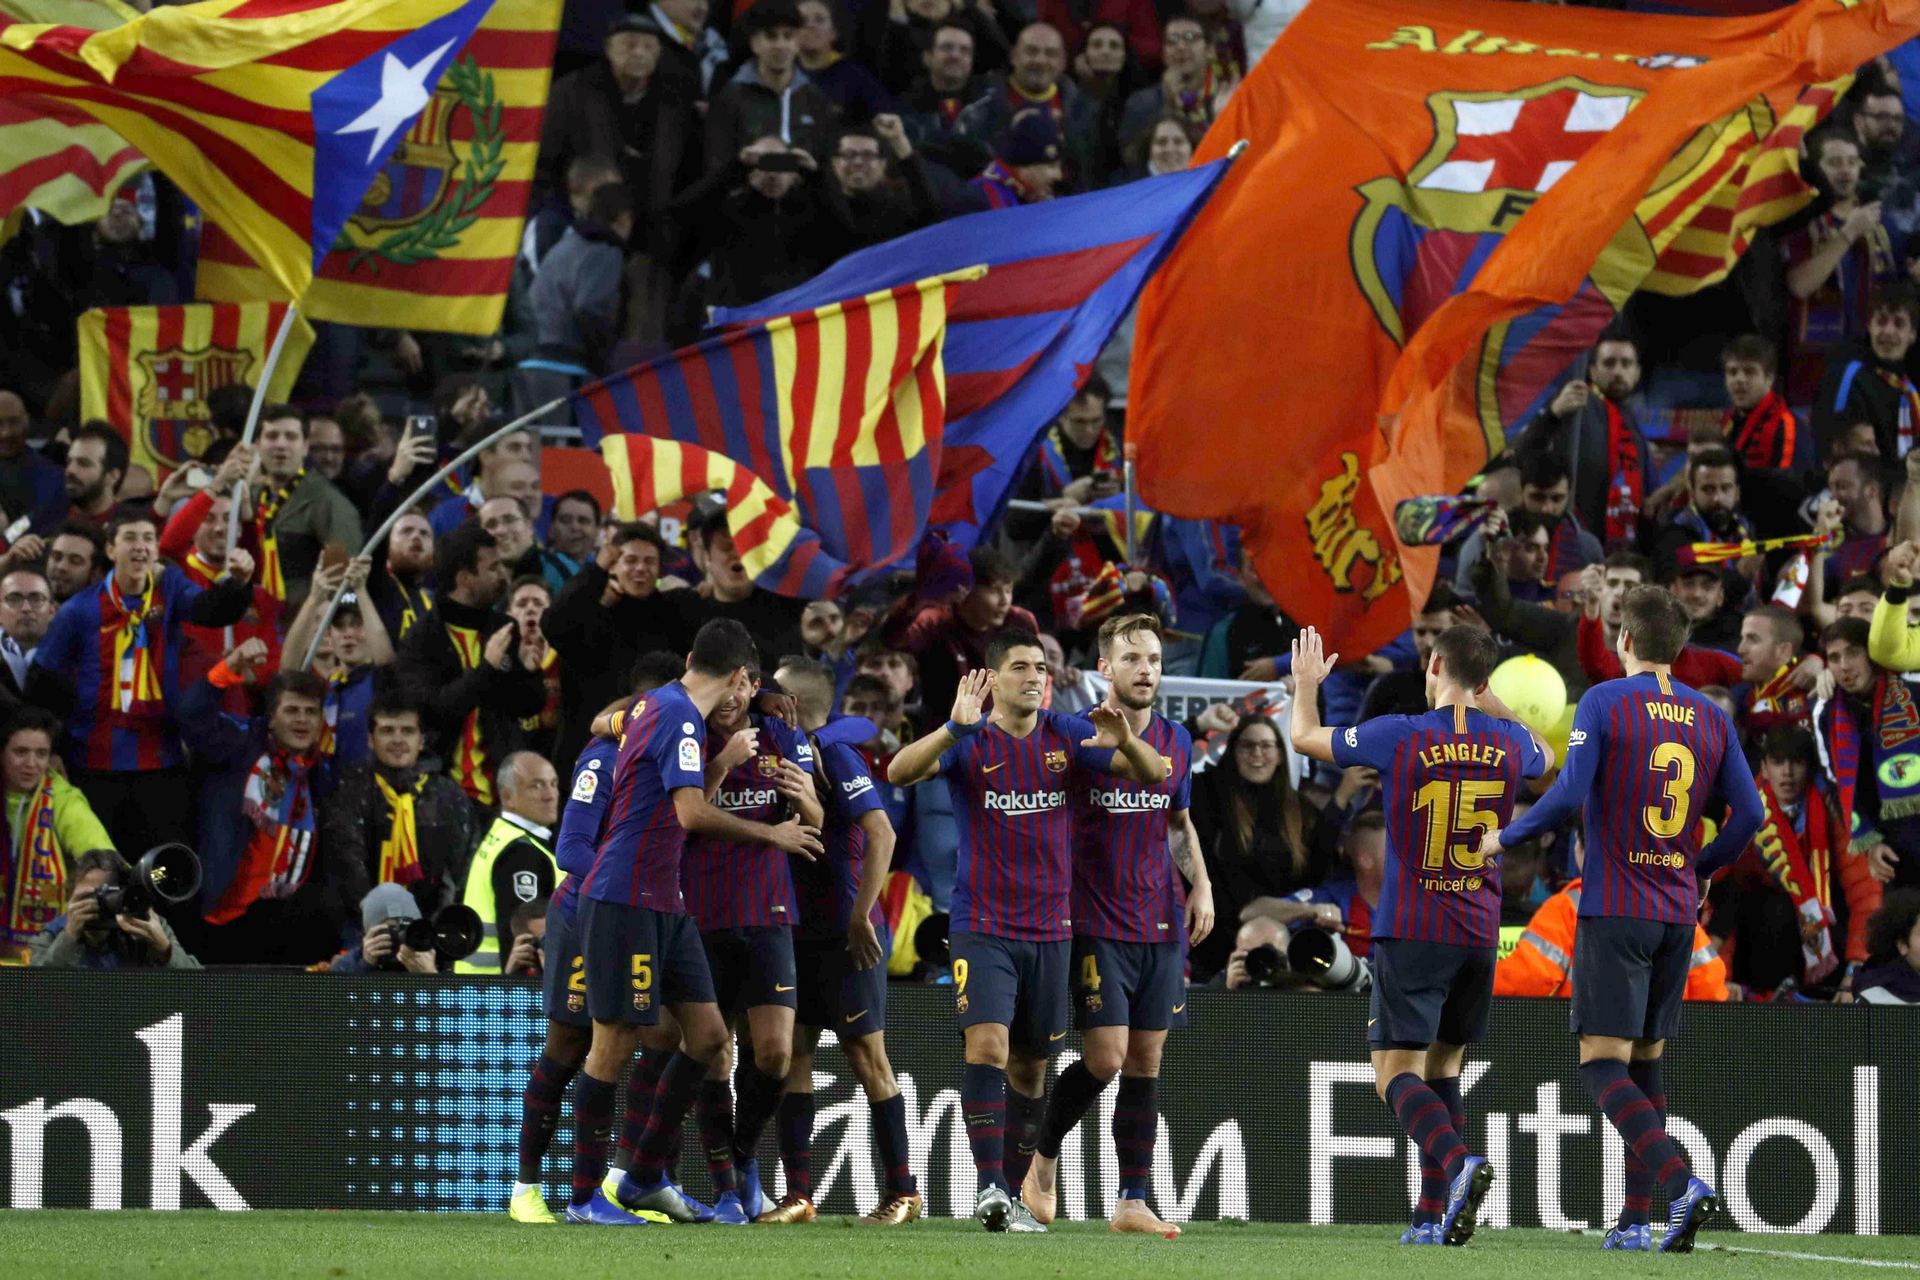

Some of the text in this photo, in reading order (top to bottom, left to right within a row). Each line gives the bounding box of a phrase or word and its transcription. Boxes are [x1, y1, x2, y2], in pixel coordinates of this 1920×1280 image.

[1645, 701, 1695, 727] PIQUÉ
[1419, 743, 1506, 768] LENGLET
[842, 775, 872, 793] beko
[1643, 742, 1695, 838] 3
[712, 788, 777, 807] kuten
[985, 789, 1066, 810] Rakuten
[1090, 788, 1171, 810] Rakuten
[1412, 780, 1506, 871] 15
[1420, 876, 1466, 892] unicef
[568, 955, 587, 992] 2
[632, 954, 652, 990] 5
[953, 958, 969, 994] 9
[1081, 954, 1102, 990] 4
